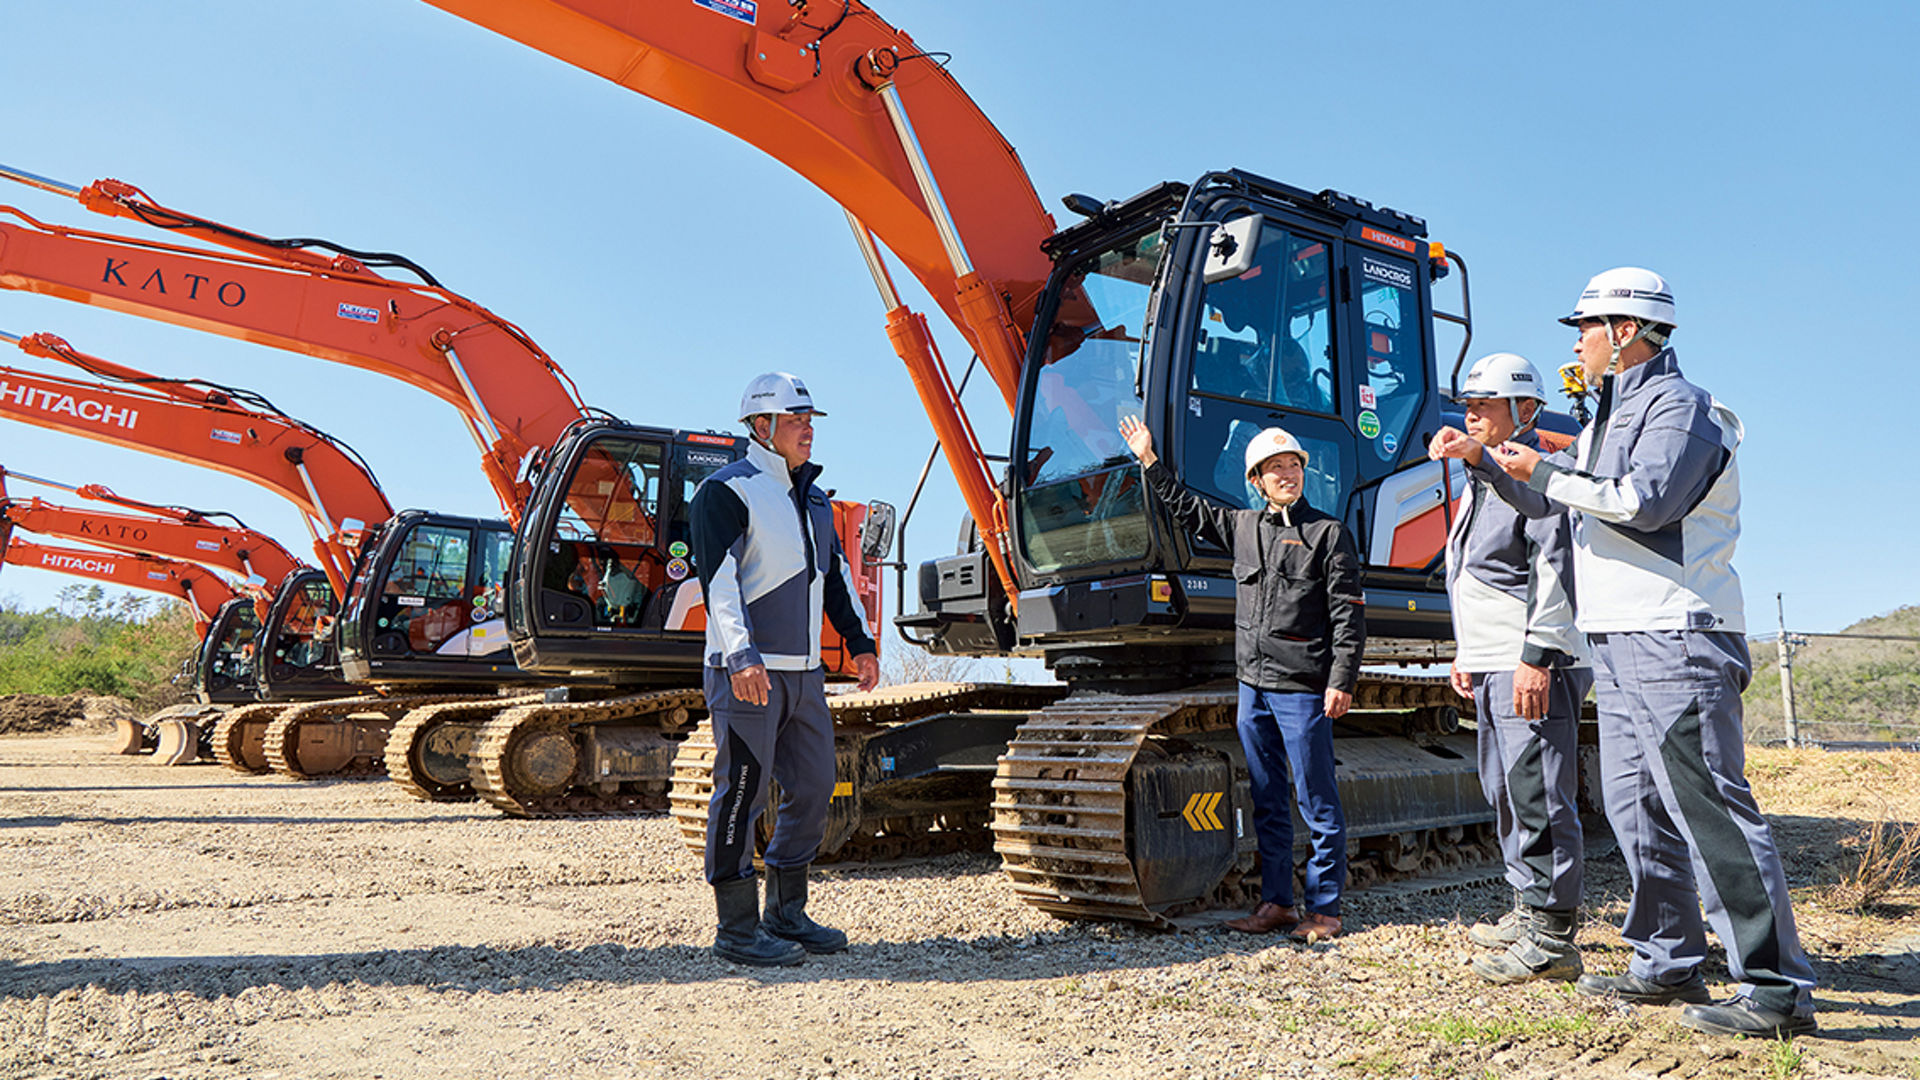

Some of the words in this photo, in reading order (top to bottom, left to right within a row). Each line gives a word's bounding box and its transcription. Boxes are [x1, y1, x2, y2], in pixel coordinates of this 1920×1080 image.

[101, 257, 247, 307] KATO
[0, 381, 139, 429] HITACHI
[80, 519, 148, 542] KATO
[42, 553, 116, 574] HITACHI
